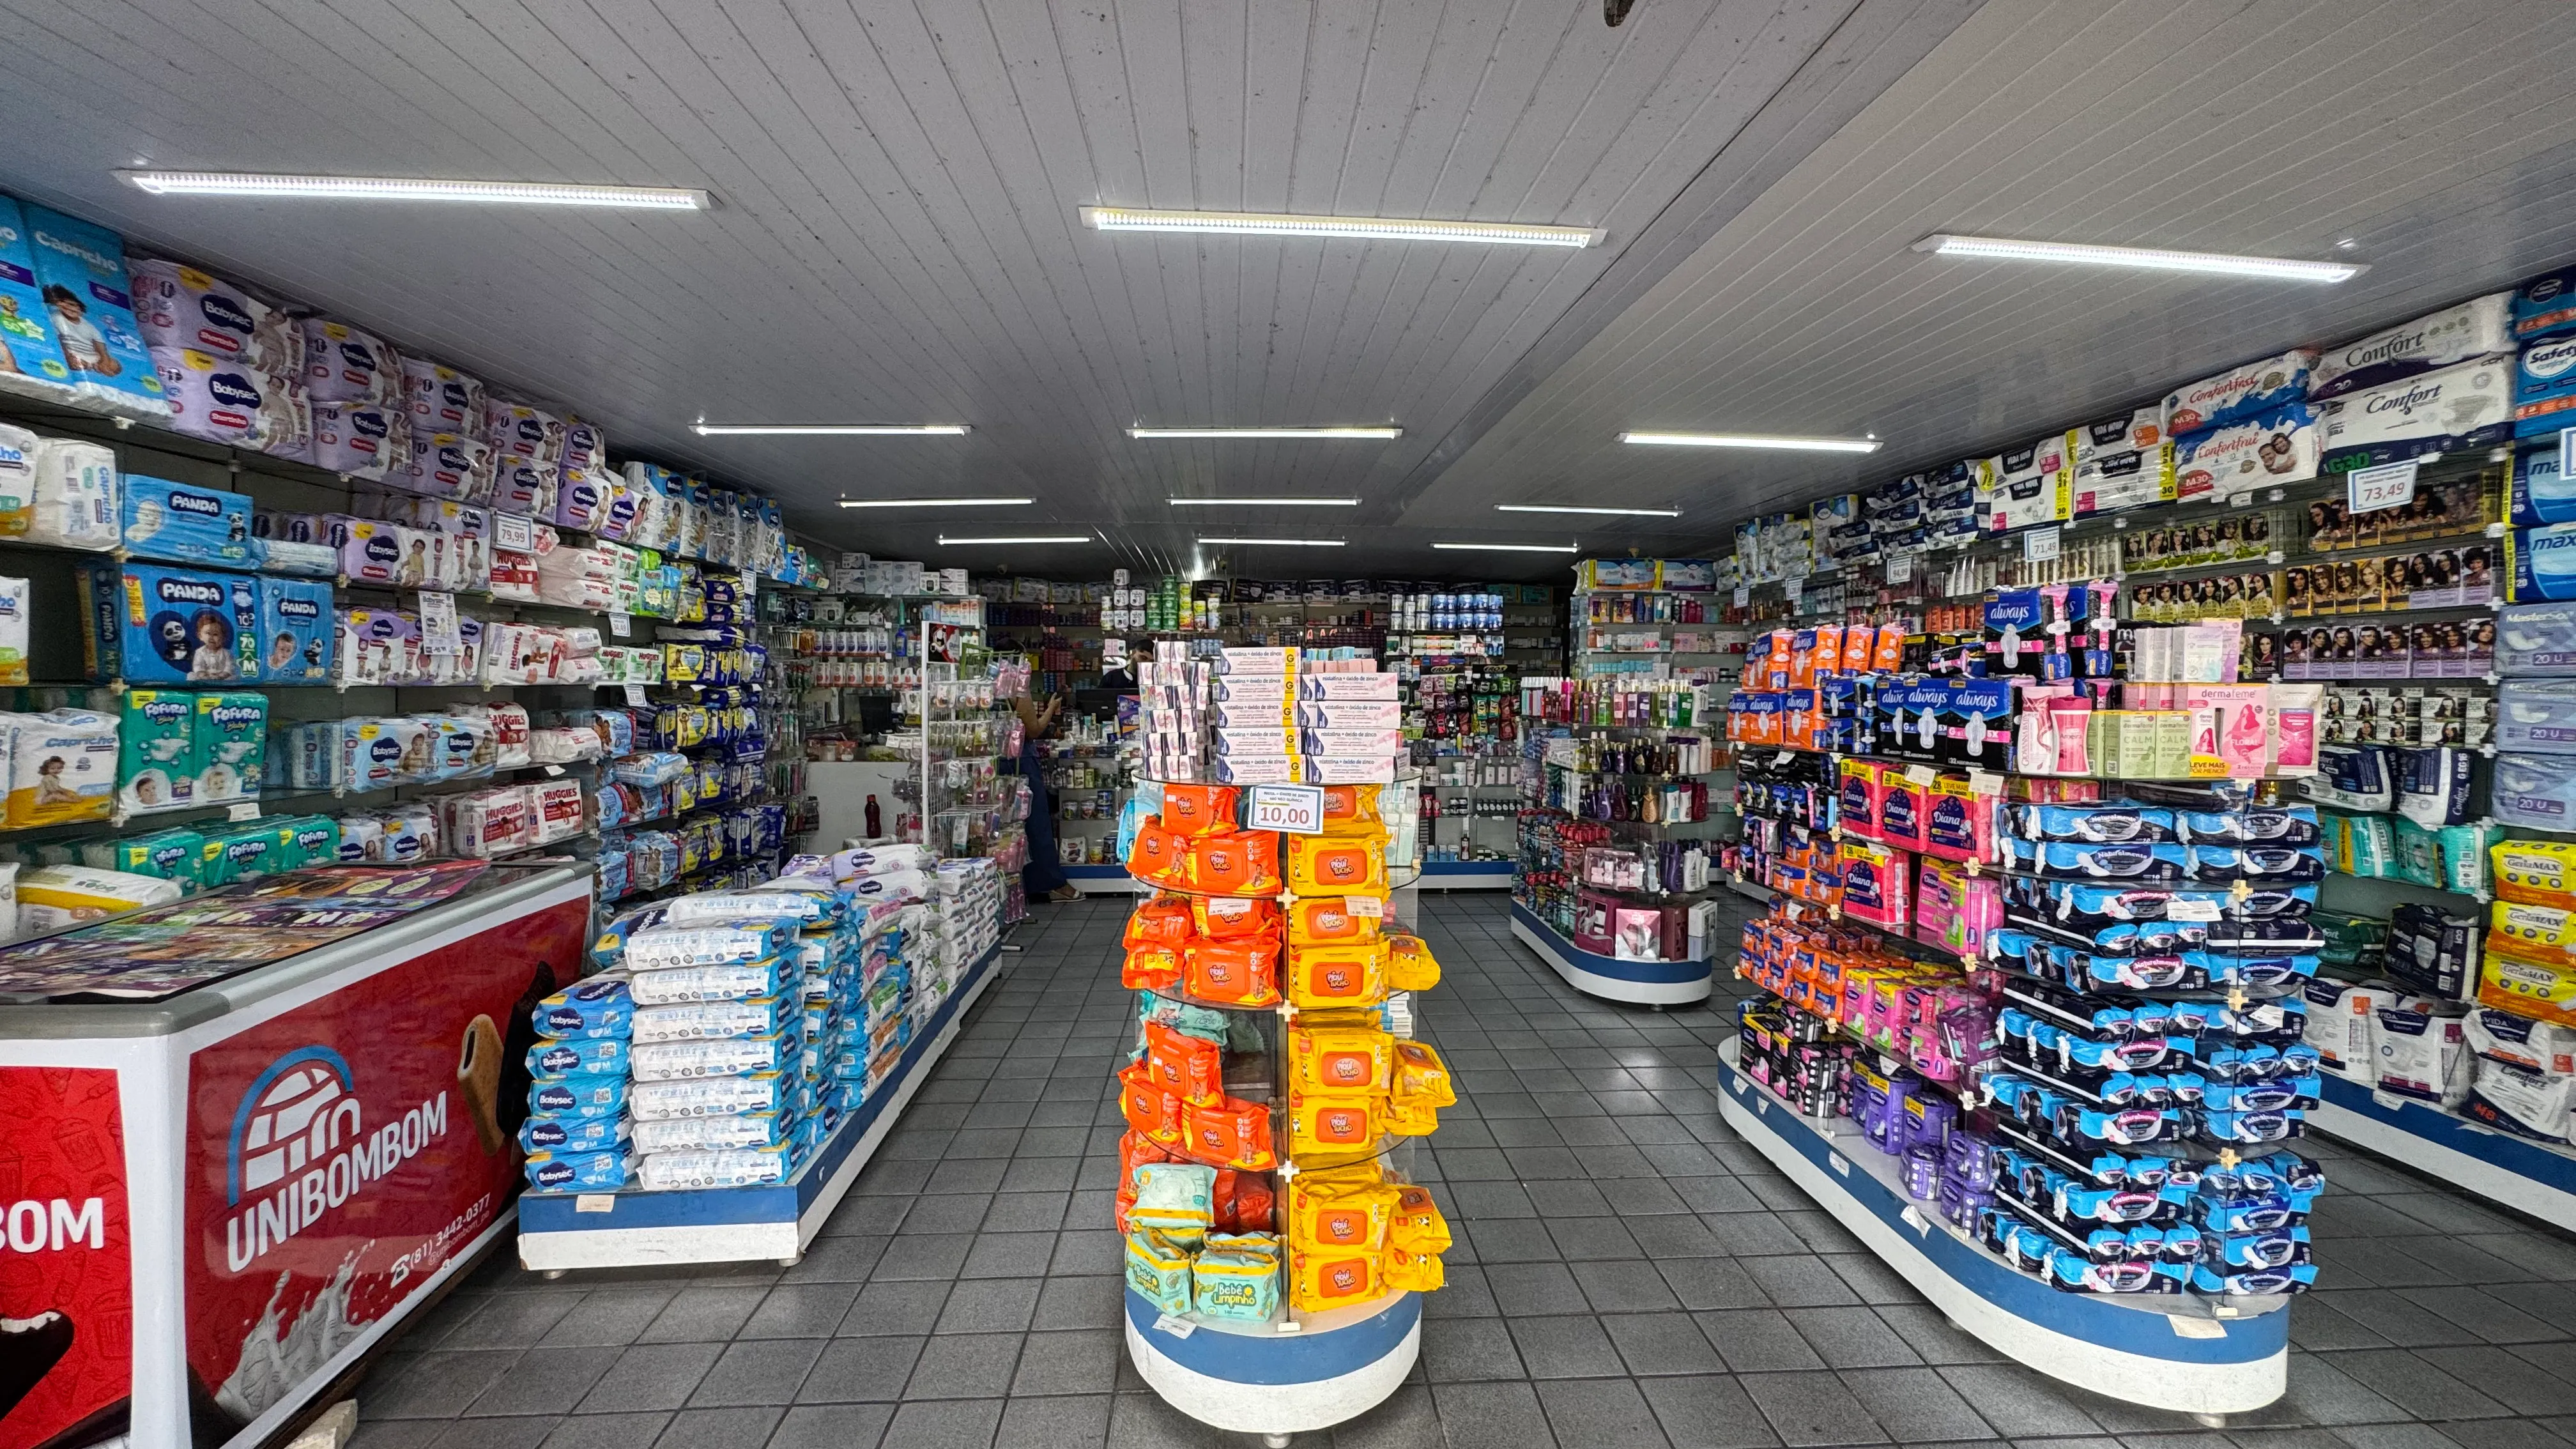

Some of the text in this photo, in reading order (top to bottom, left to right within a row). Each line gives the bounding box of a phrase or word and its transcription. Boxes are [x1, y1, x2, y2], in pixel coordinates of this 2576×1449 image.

[204, 302, 251, 326] Babysec
[2346, 330, 2425, 367] Confort
[214, 381, 258, 402] Babysec
[2366, 384, 2442, 415] Confort
[2174, 414, 2196, 425] M30
[2329, 452, 2369, 473] G30
[2186, 475, 2209, 486] M30
[2364, 482, 2405, 502] 73,49
[172, 495, 218, 512] PANDA
[2512, 504, 2525, 513] 20
[502, 524, 525, 542] 79,99
[369, 545, 398, 558] Babysec
[2034, 542, 2056, 555] 71,49
[497, 553, 531, 567] HUGGIES
[2517, 579, 2528, 588] 20
[163, 583, 220, 602] PANDA
[281, 602, 316, 615] PANDA
[1990, 604, 2030, 624] always
[101, 604, 114, 640] PANDA
[240, 637, 254, 648] 70
[510, 631, 521, 671] HUGGIES
[1287, 654, 1294, 663] G
[2535, 654, 2550, 664] 20
[243, 661, 256, 672] M
[1286, 681, 1293, 689] G
[1909, 689, 1947, 708] always
[2202, 689, 2255, 698] dermafeme
[1751, 699, 1774, 714] always
[1787, 696, 1809, 712] always
[1956, 692, 1998, 712] always
[145, 703, 187, 716] FOFURA
[213, 709, 261, 722] FOFURA
[1284, 707, 1291, 716] G
[1286, 734, 1294, 744] G
[2533, 728, 2546, 739] 20
[46, 737, 116, 748] Capricho
[449, 738, 472, 747] Babysec
[372, 746, 399, 756] Babysec
[1291, 762, 1300, 771] G
[1885, 774, 1892, 782] 28
[1933, 780, 1942, 789] 28
[544, 788, 578, 801] HUGGIES
[1844, 790, 1863, 802] Diana
[486, 802, 524, 818] HUGGIES
[1886, 802, 1908, 815] Diana
[2519, 798, 2533, 809] 20
[1261, 807, 1309, 824] 10,00
[1934, 811, 1960, 825] Diana
[298, 831, 329, 846] FOFURA
[229, 843, 266, 859] FOFURA
[2098, 850, 2147, 859] Naturalmente
[2507, 859, 2561, 872] GeriaMAX
[1848, 873, 1871, 887] Diana
[2504, 965, 2555, 983] GeriaMAX
[550, 1015, 581, 1025] Babysec
[2484, 1016, 2508, 1027] VIDA
[2119, 1042, 2164, 1054] Naturalmente
[543, 1055, 577, 1067] Babysec
[2502, 1066, 2547, 1087] Confort
[539, 1096, 574, 1105] Babysec
[532, 1131, 564, 1140] Babysec
[539, 1169, 572, 1180] Babysec
[227, 1091, 448, 1273] UNIBOMBOM
[0, 1197, 103, 1253] OM
[410, 1192, 490, 1269] (81) 3442-0377
[1219, 1283, 1243, 1295] Bebê
[1214, 1294, 1255, 1307] Limpinho
